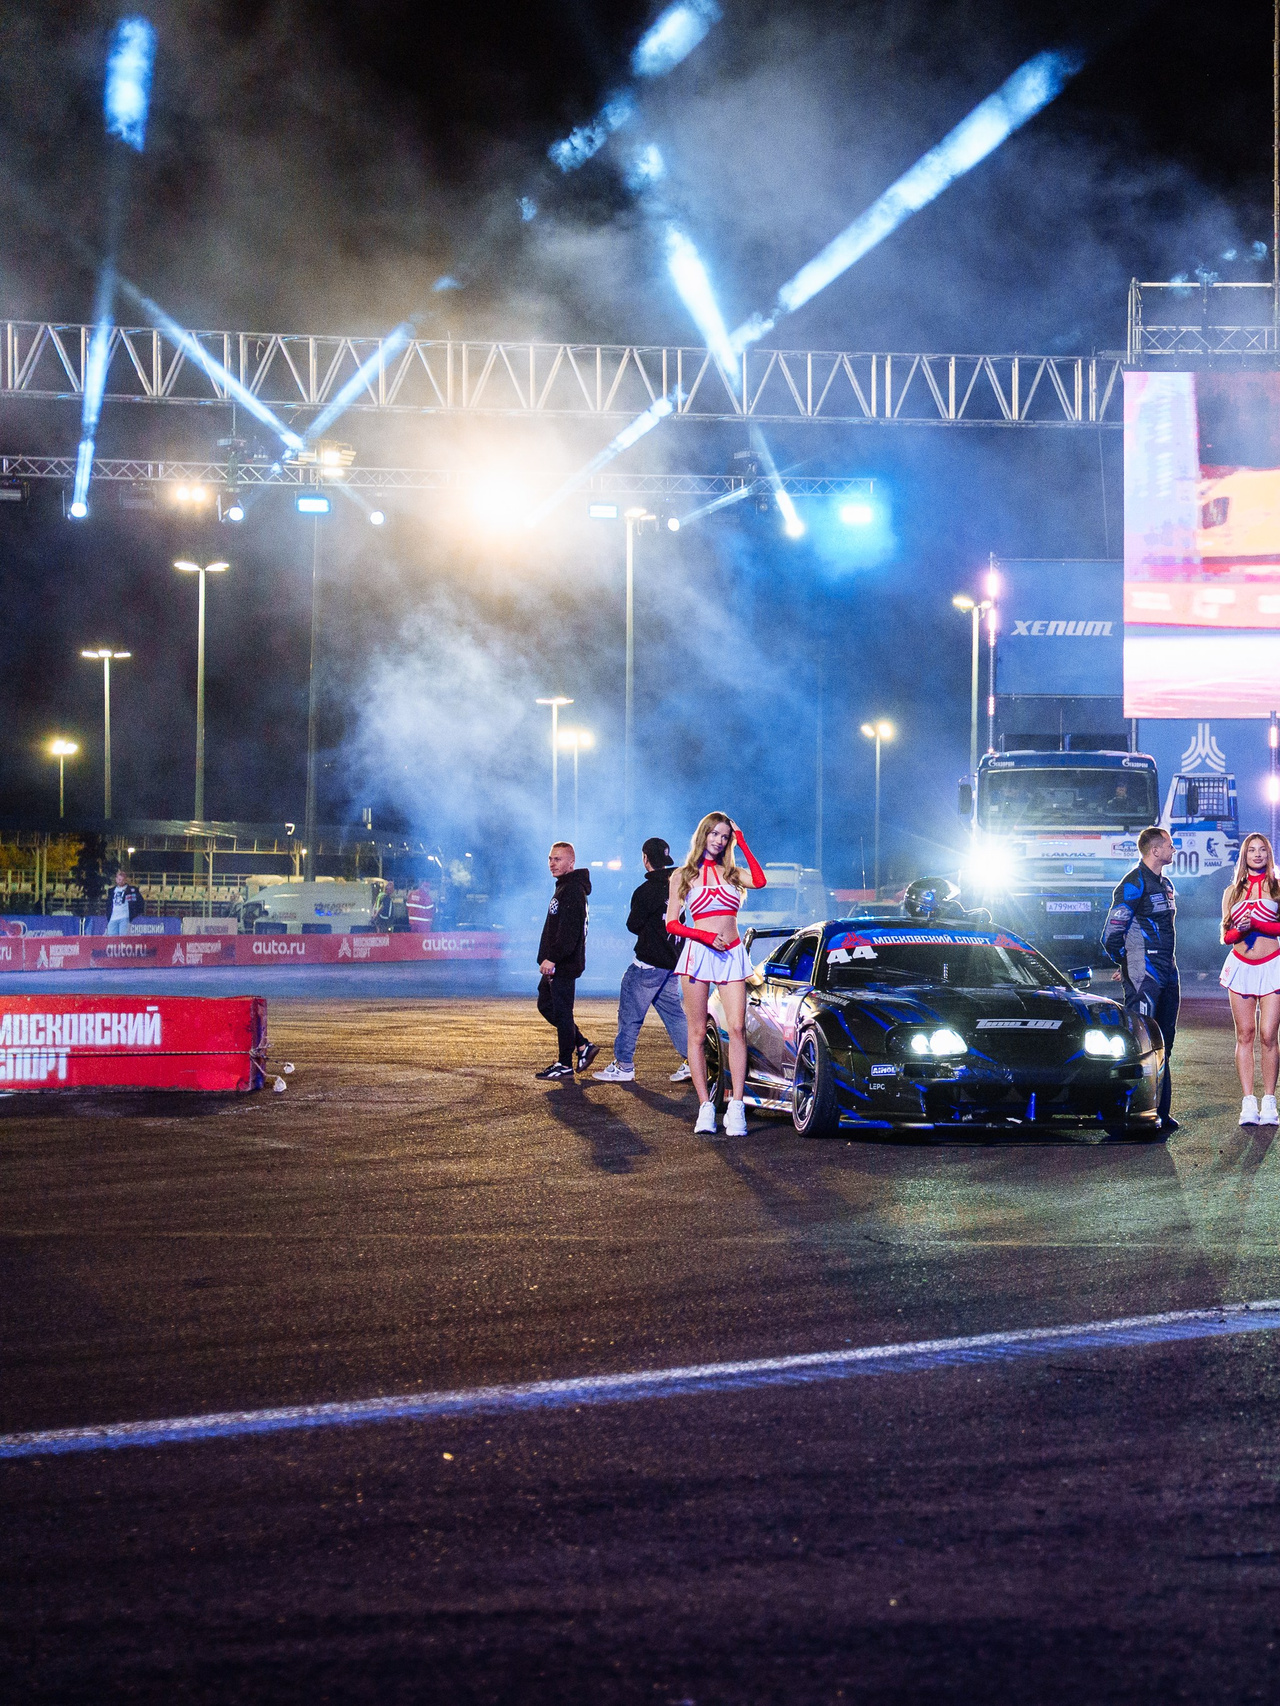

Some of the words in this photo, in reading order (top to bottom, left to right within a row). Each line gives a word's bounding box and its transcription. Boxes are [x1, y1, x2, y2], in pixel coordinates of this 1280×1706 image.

[1010, 620, 1114, 636] XENUM
[130, 922, 165, 934] СКОВСКИЙ
[252, 939, 306, 956] auto.ru
[421, 935, 475, 952] auto.ru
[871, 934, 954, 945] МОСКОВСКИЙ
[957, 936, 992, 946] СПОРТ
[106, 941, 148, 958] auto.ru
[826, 945, 879, 964] 44
[0, 1006, 162, 1046] МОСКОВСКИЙ
[872, 1066, 897, 1074] AIMOL
